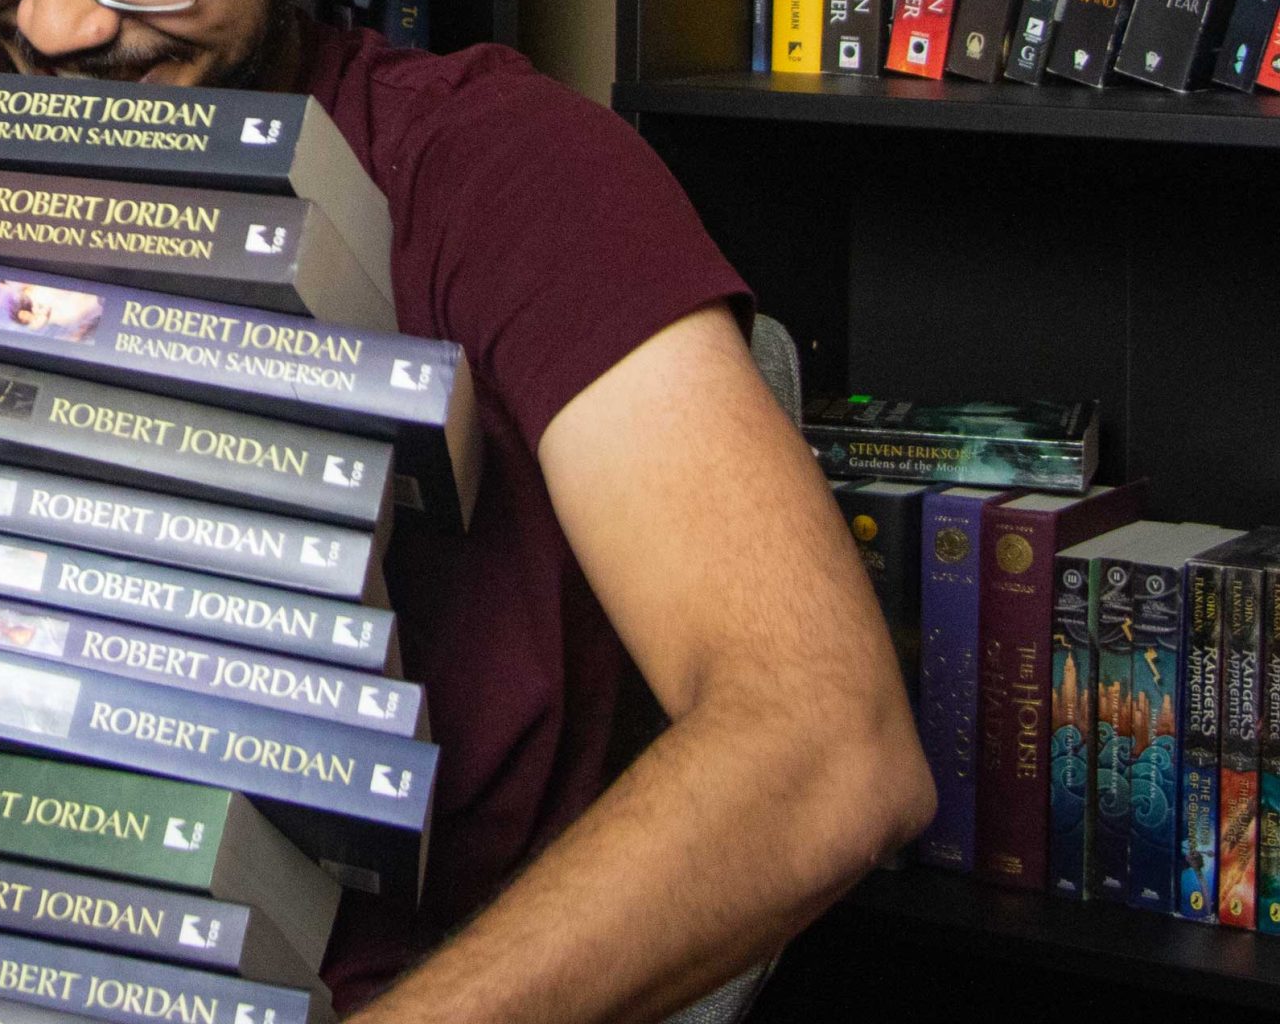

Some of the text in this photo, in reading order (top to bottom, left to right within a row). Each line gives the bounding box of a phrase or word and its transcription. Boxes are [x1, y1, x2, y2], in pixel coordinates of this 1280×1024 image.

[401, 5, 418, 29] Tu
[99, 94, 216, 128] JORDAN
[85, 126, 209, 152] SANDERSON
[101, 196, 220, 233] JORDAN
[88, 229, 213, 260] SANDERSON
[121, 300, 362, 366] ROBERT JORDAN
[114, 333, 356, 394] BRANDON SANDERSON
[49, 397, 308, 478] ROBERT JORDAN
[849, 442, 972, 460] STEVEN ERIKSON
[849, 458, 968, 474] Gardens of the Moon
[57, 563, 318, 641] ROBERT JORDAN
[88, 699, 356, 787] ROBERT JORDAN
[23, 797, 150, 844] JORDAN
[32, 890, 166, 939] JORDAN
